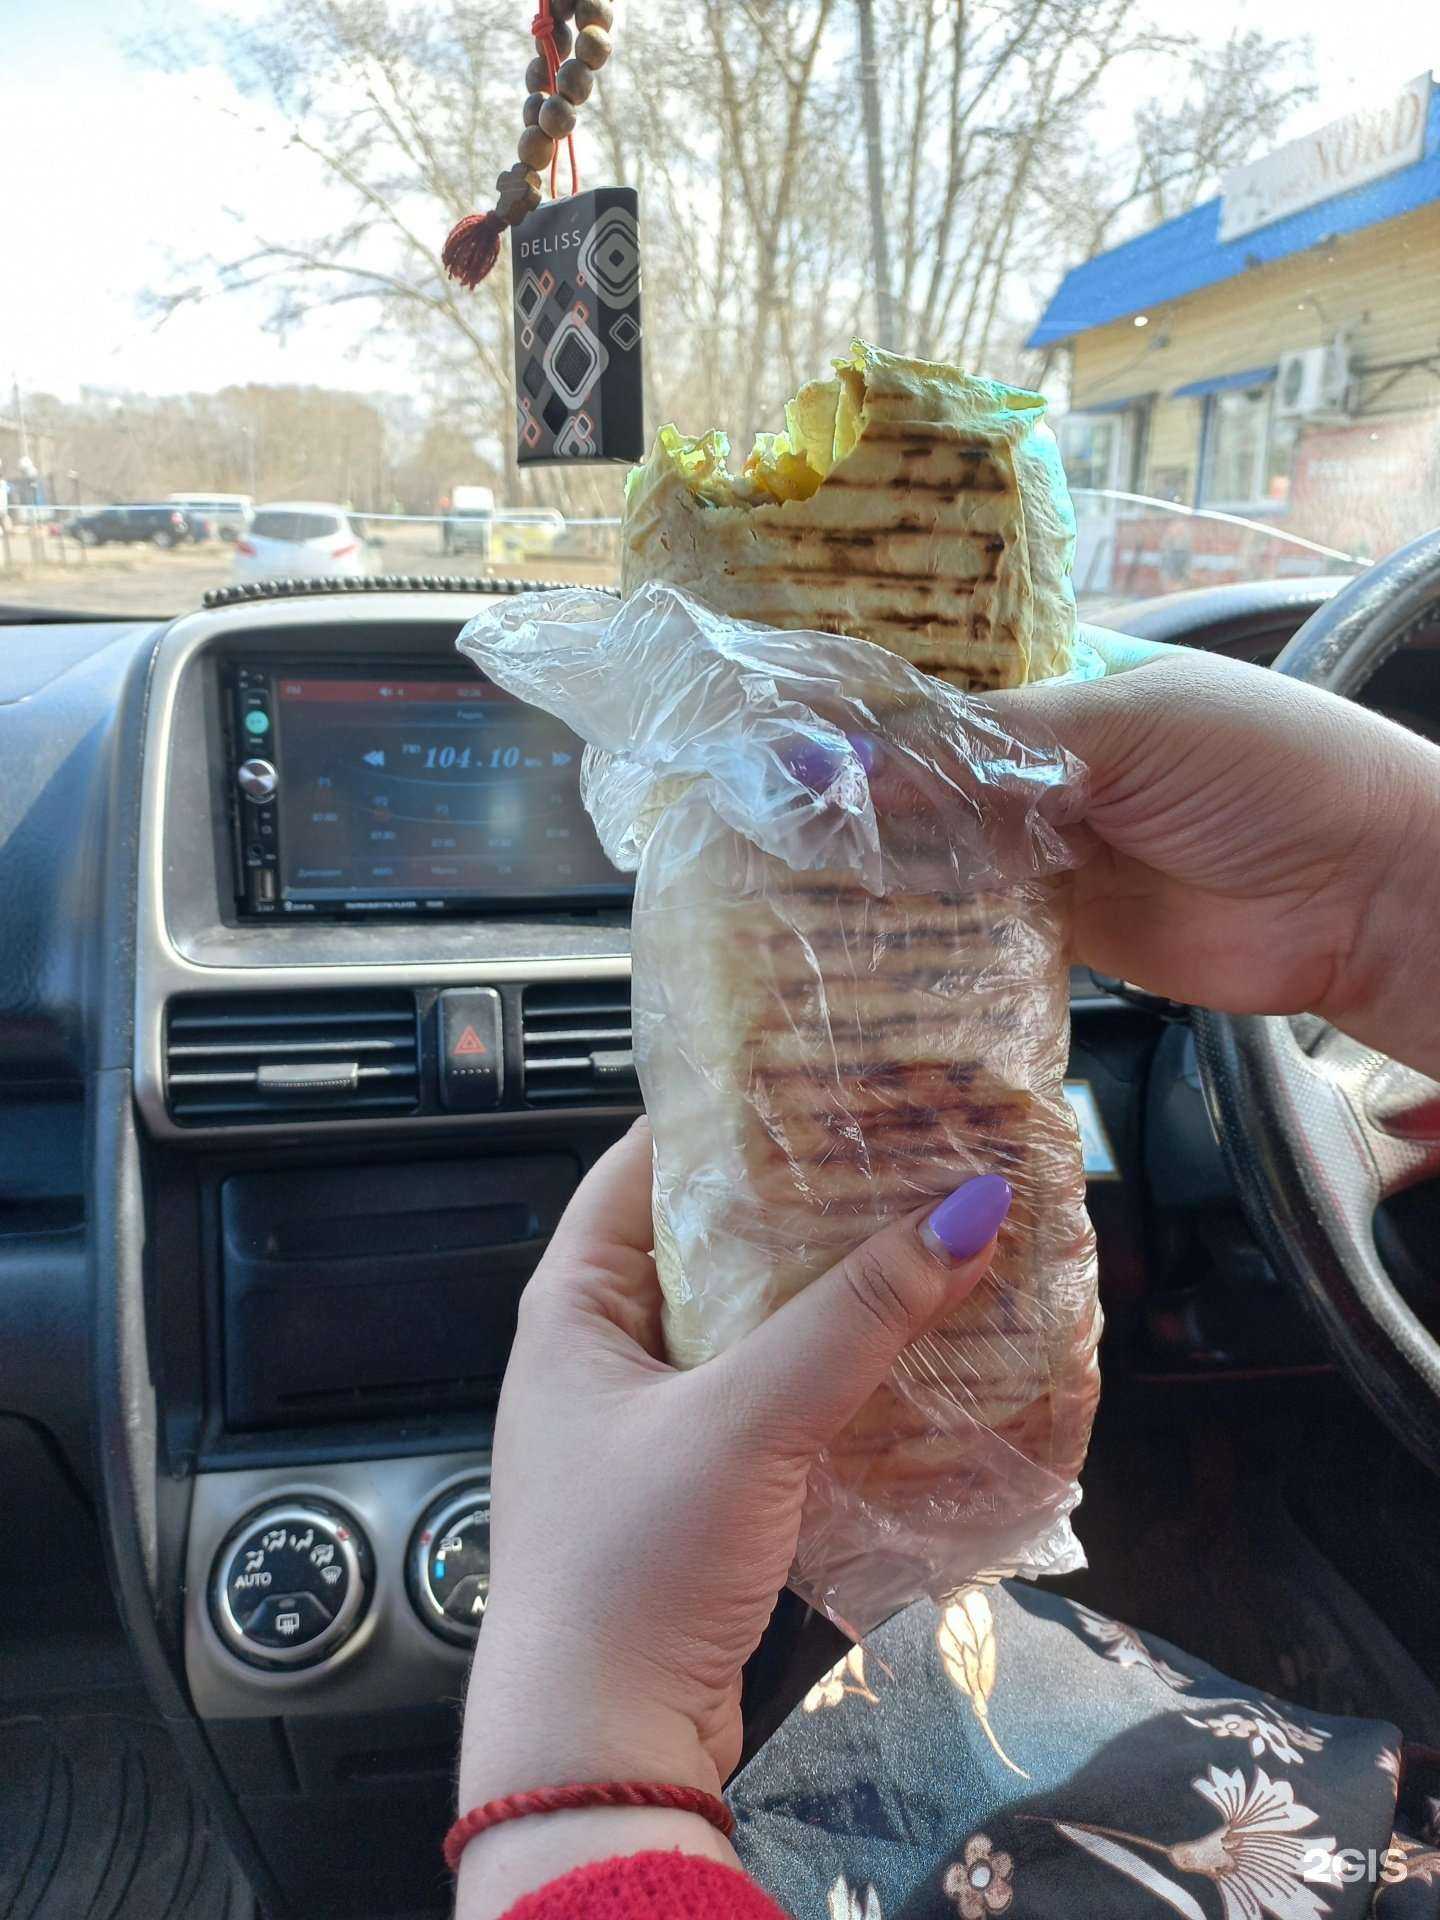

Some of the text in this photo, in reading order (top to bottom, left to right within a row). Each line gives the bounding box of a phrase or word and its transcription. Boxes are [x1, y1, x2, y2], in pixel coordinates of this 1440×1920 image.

[521, 230, 581, 258] DELISS
[423, 746, 521, 769] 104.10
[233, 1571, 273, 1589] AUTO
